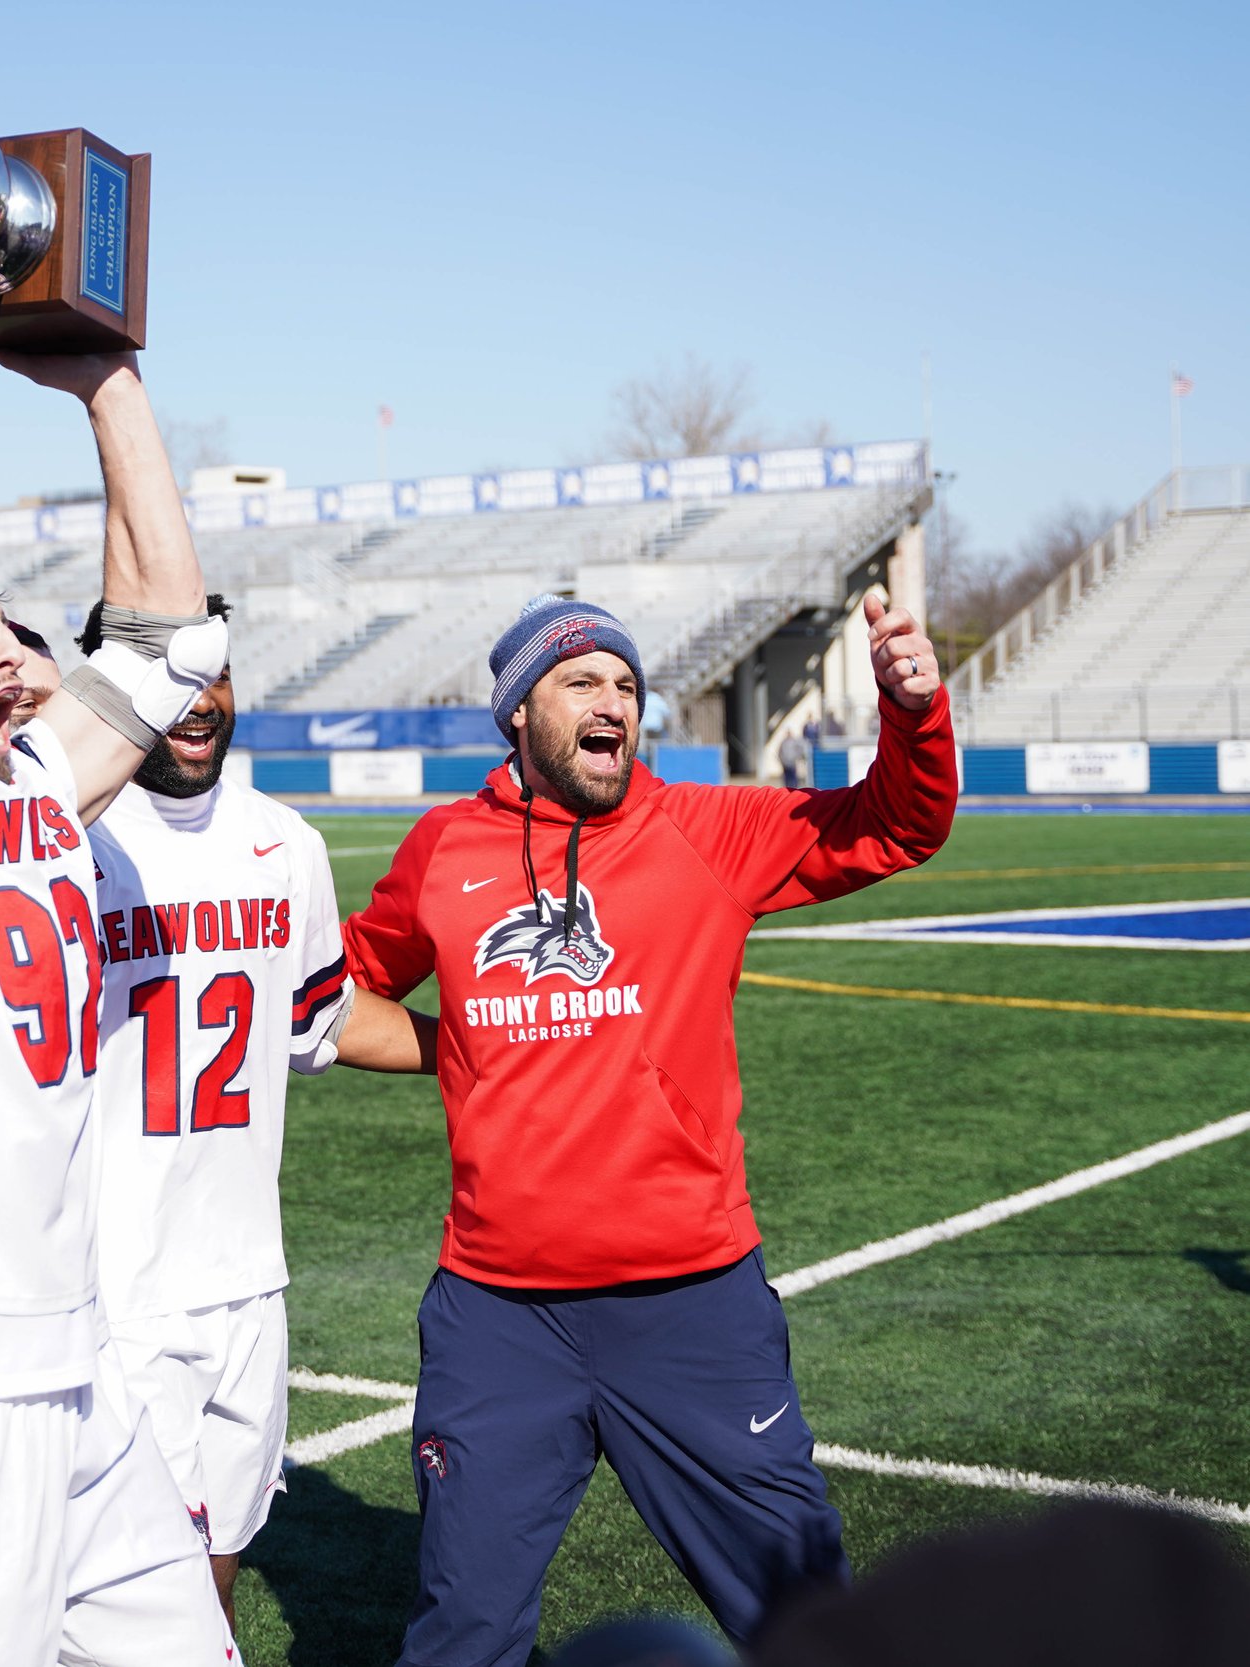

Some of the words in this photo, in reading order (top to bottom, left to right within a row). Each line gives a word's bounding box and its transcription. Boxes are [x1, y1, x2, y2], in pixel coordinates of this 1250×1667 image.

[91, 173, 99, 231] ISLAND
[89, 234, 97, 280] LONG
[106, 182, 116, 290] CHAMPION
[465, 994, 540, 1027] STONY
[550, 984, 643, 1022] BROOK
[128, 970, 255, 1137] 12
[508, 1022, 593, 1043] LACROSSE
